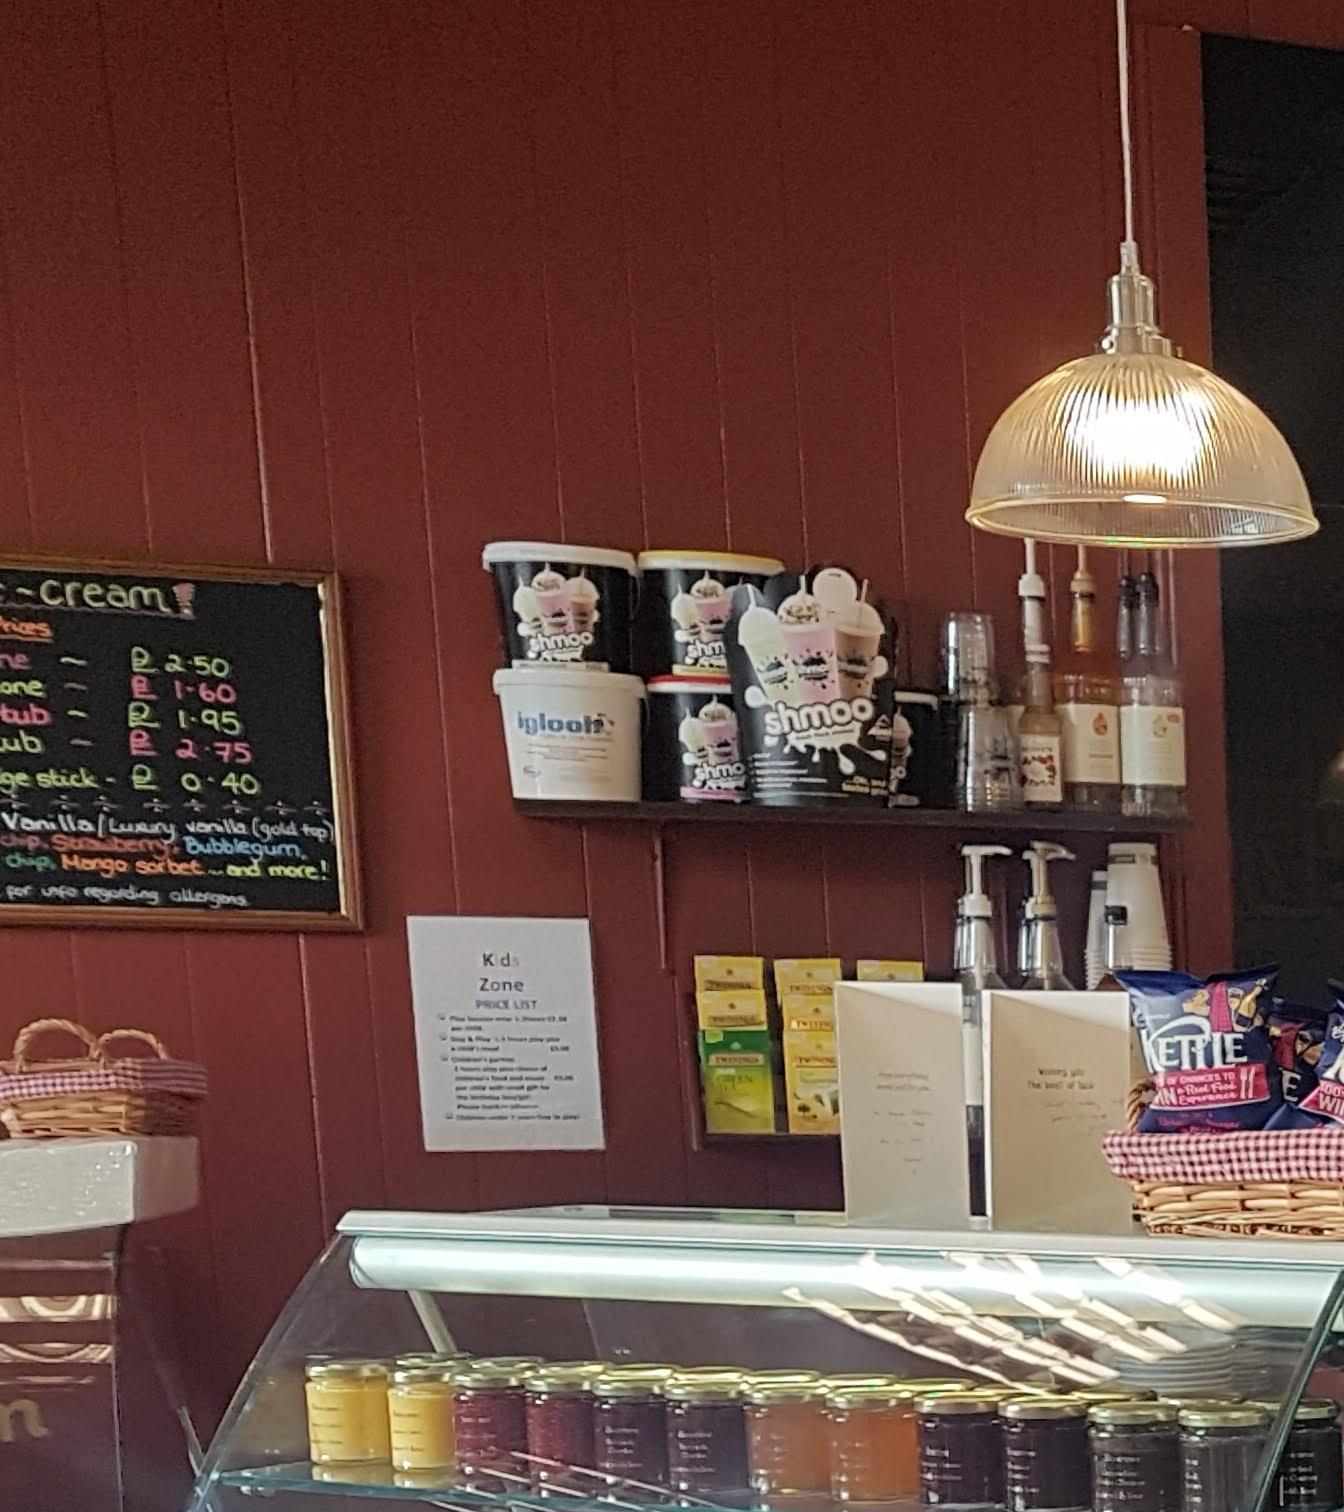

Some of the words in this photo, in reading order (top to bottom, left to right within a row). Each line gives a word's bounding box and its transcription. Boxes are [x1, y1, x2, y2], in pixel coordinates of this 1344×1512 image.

[687, 640, 725, 659] shm
[764, 697, 875, 736] shmoo
[694, 762, 746, 782] shmo
[479, 977, 525, 993] Zone
[1141, 1016, 1248, 1075] KETTLE
